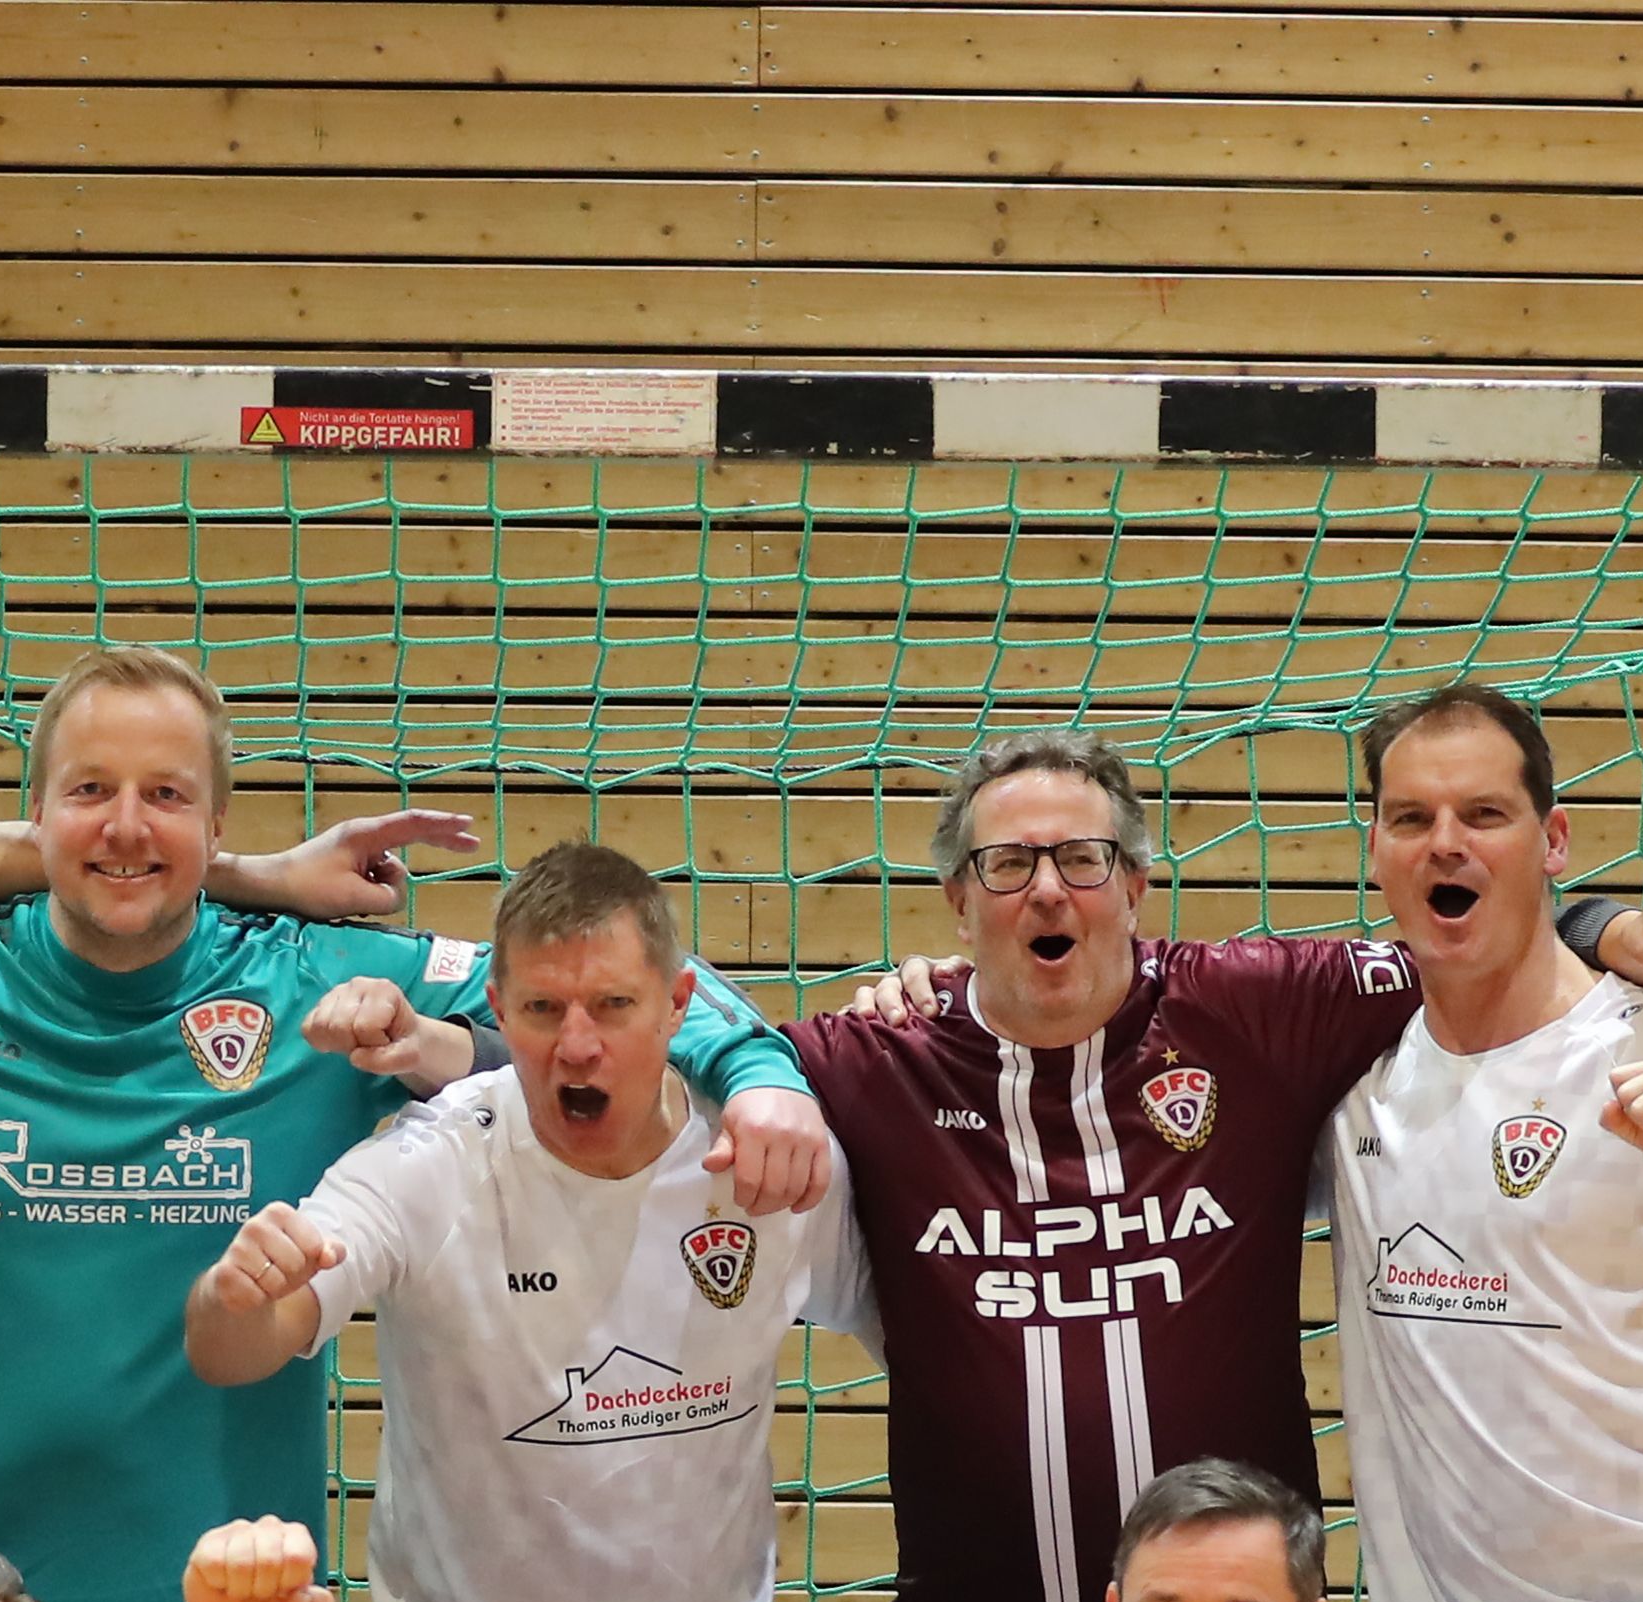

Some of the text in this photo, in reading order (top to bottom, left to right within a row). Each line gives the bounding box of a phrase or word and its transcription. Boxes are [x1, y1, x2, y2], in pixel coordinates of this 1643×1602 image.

[300, 411, 461, 426] Nicht an die Torlatte hängen!
[299, 425, 461, 447] KIPPGEFAHR!
[188, 1003, 260, 1035] BFC
[1146, 1071, 1208, 1102] BFC
[933, 1108, 988, 1131] JAKO
[1356, 1136, 1382, 1157] JAKO
[1504, 1121, 1561, 1149] BFC
[24, 1203, 127, 1224] WASSER
[150, 1204, 251, 1224] HEIZUNG
[913, 1185, 1235, 1258] ALPHA
[688, 1227, 747, 1257] BFC
[973, 1256, 1184, 1319] SUN
[1386, 1263, 1509, 1293] Dachdeckerei
[1408, 1291, 1459, 1312] Rüdiger
[1462, 1296, 1508, 1313] GmbH
[585, 1375, 733, 1413] Dachdeckerei
[557, 1398, 729, 1434] Thomas Rüdiger GmbH
